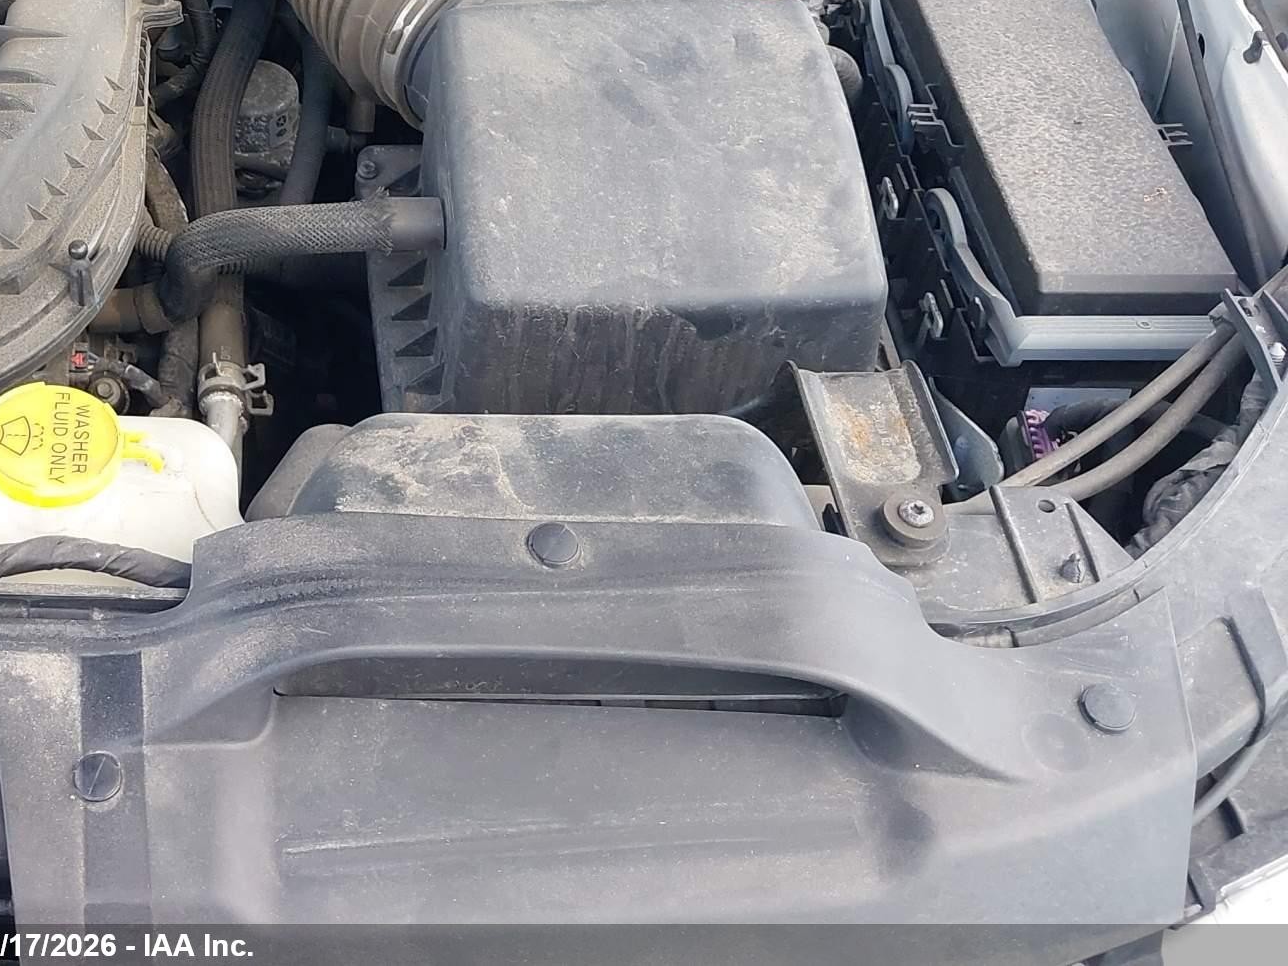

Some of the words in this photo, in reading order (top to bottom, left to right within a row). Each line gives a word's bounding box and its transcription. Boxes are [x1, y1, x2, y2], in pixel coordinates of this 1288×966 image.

[53, 392, 71, 437] FLUID
[72, 404, 90, 474] WASHER
[48, 442, 68, 484] ONLY
